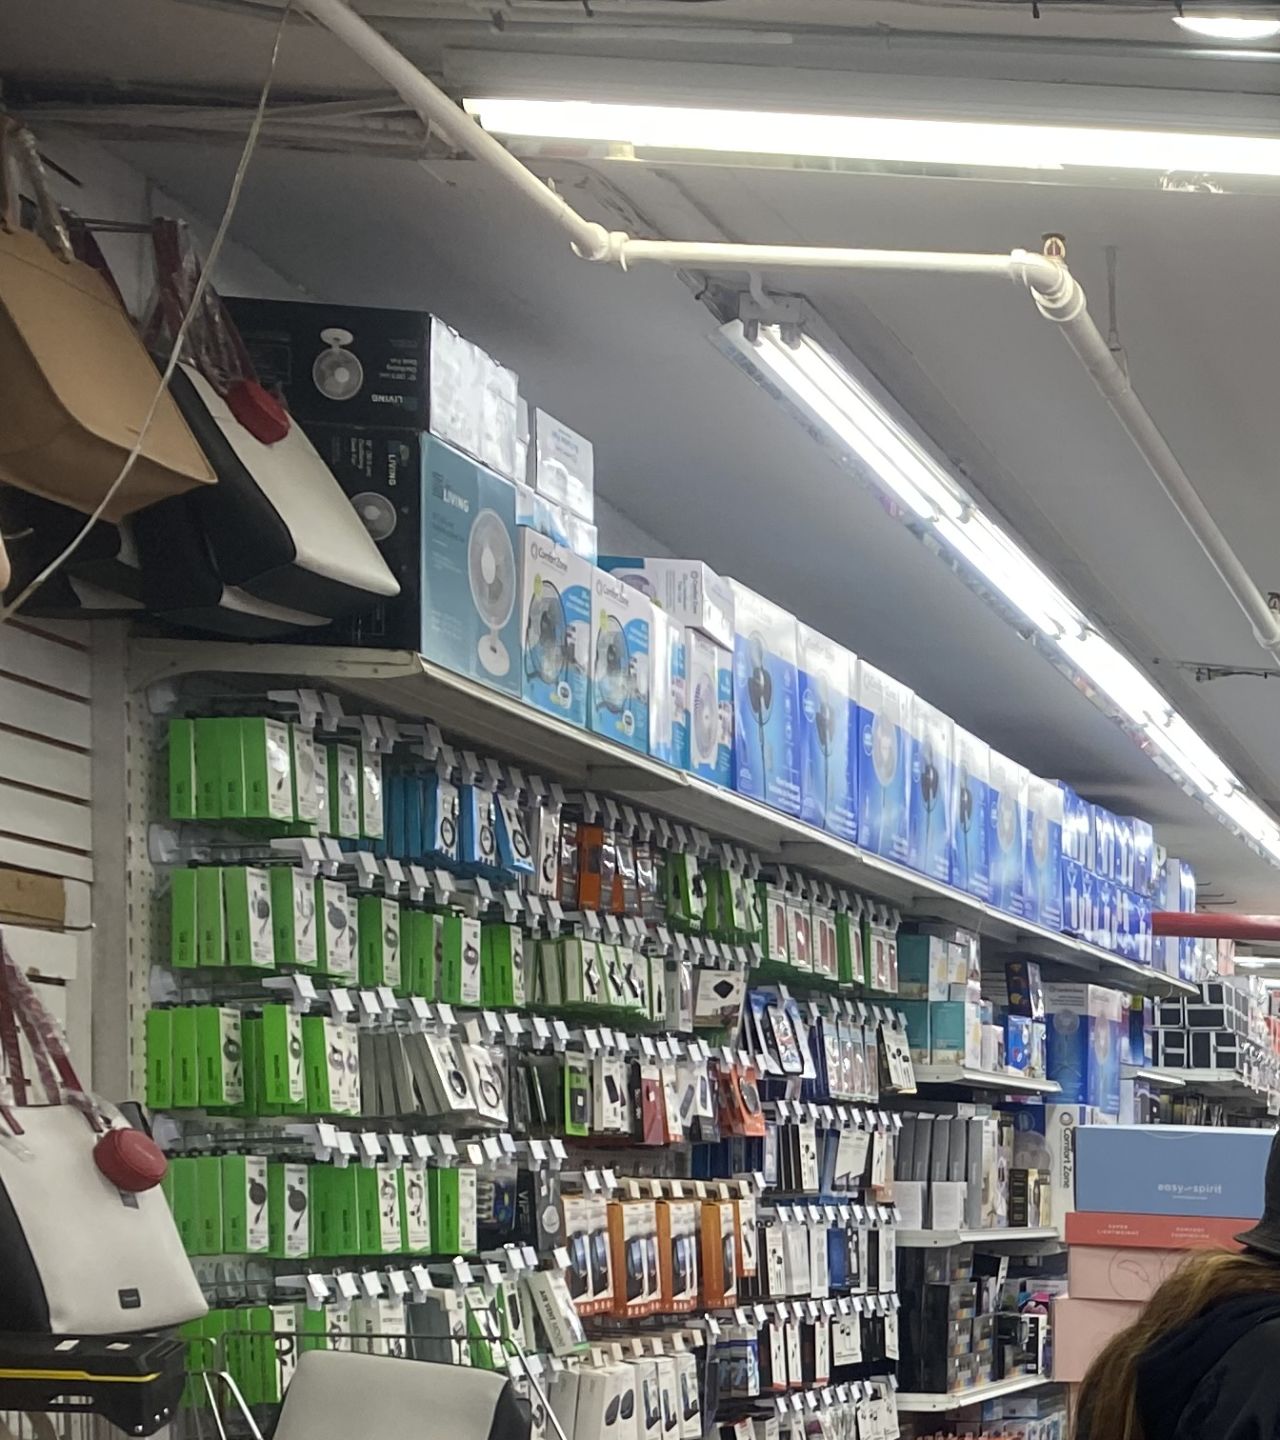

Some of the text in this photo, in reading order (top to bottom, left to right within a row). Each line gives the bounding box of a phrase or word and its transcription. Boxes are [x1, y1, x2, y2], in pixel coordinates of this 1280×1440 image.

[388, 454, 396, 486] LIVING
[443, 488, 470, 513] LIVING
[1063, 1127, 1073, 1188] Comfort Zone
[1158, 1183, 1222, 1195] easy spirit
